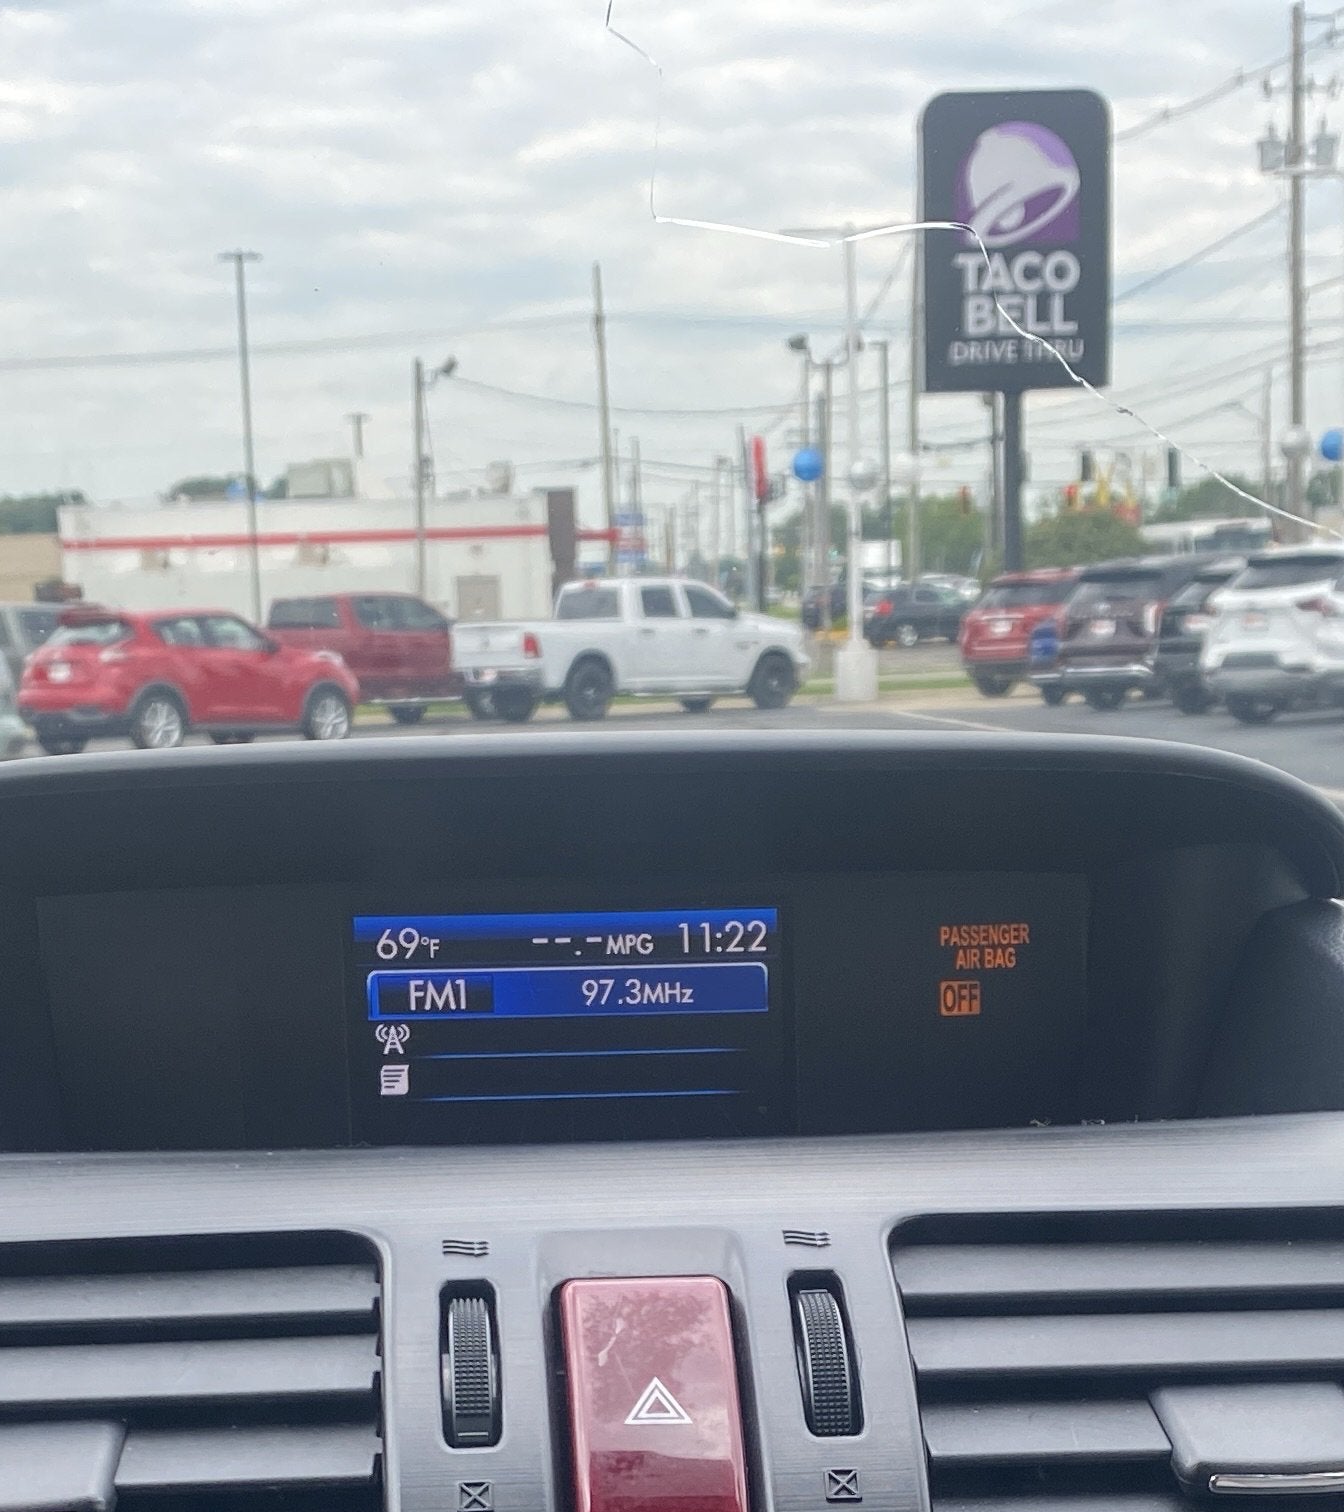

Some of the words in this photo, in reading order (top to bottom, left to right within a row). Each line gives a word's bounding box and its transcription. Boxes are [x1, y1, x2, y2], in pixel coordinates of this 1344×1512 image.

[955, 250, 1081, 293] TACO
[963, 293, 1079, 336] BELL
[950, 339, 1019, 364] DRIVE
[1022, 338, 1084, 361] THRU
[677, 919, 768, 955] 11:22
[940, 923, 1030, 947] PASSENGER
[955, 948, 981, 970] AIR
[984, 946, 1017, 969] BAG
[409, 978, 467, 1011] FM1
[581, 978, 694, 1007] 97.3MHz
[943, 984, 979, 1012] OFF
